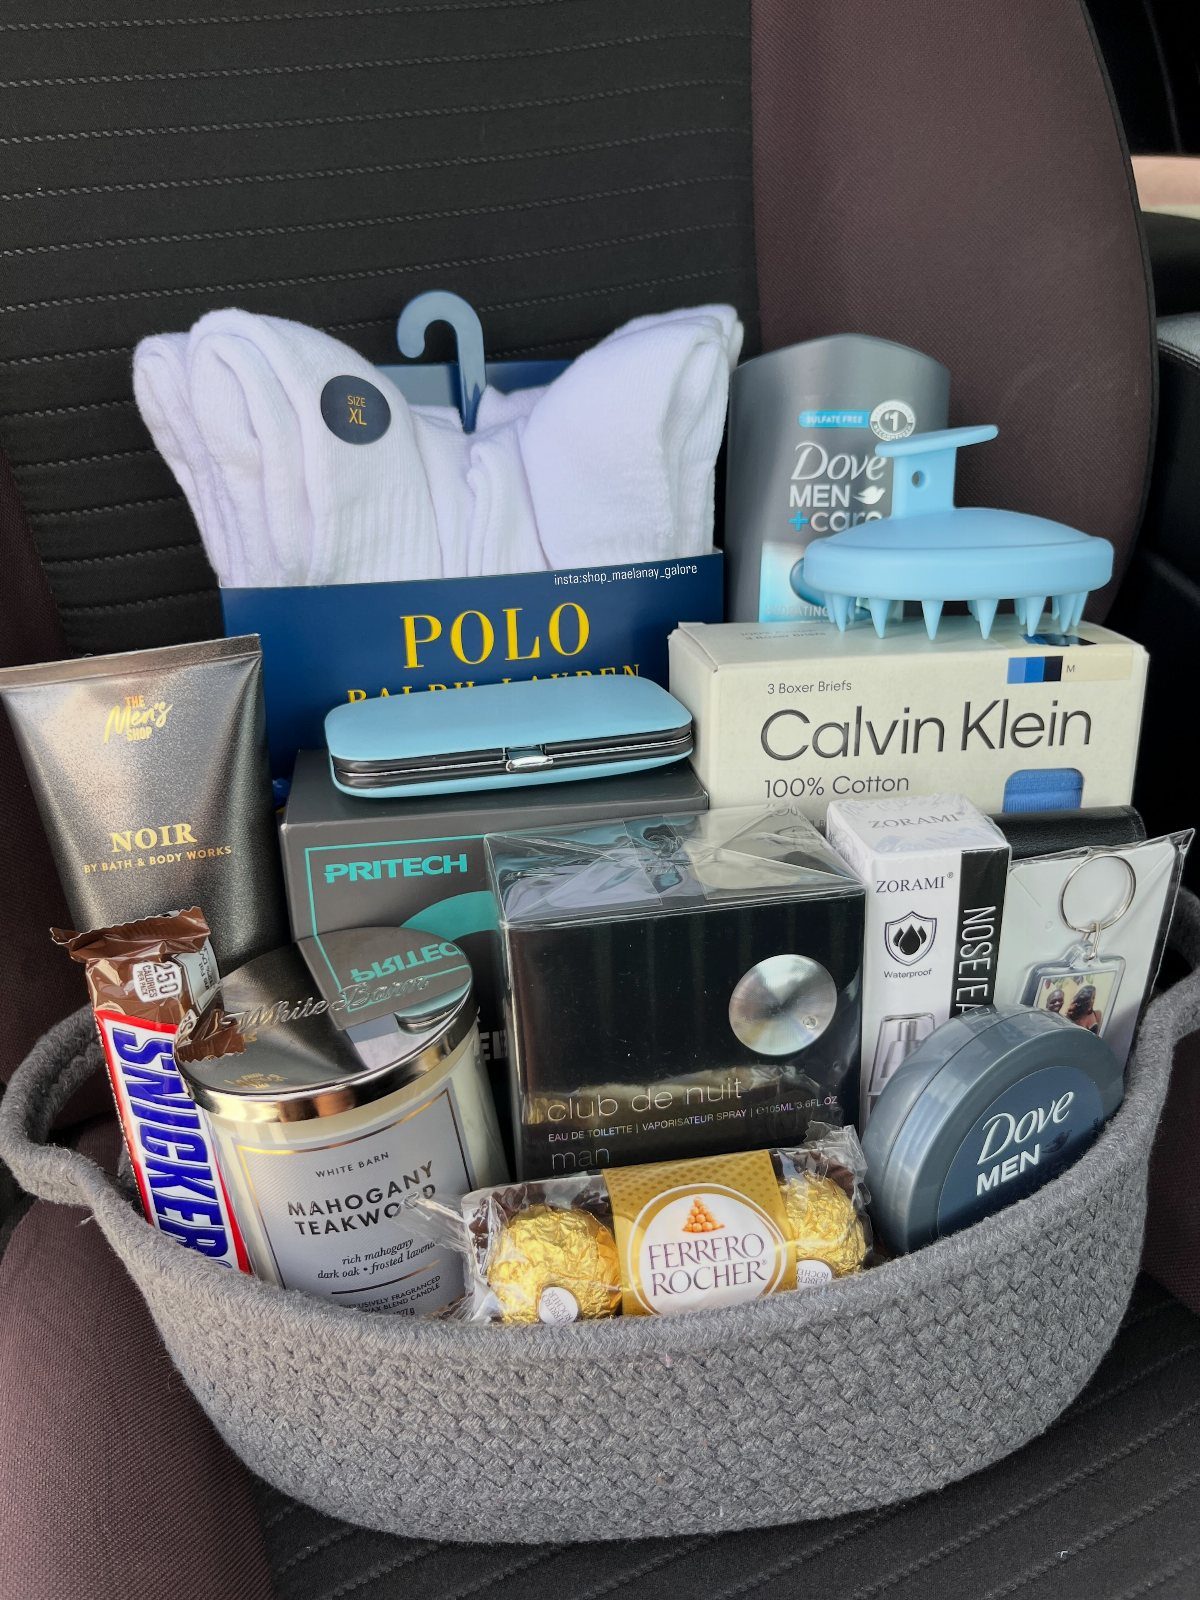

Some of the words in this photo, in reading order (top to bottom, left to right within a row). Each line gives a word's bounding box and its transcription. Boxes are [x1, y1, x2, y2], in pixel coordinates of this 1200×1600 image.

[346, 394, 367, 408] SIZE
[348, 407, 367, 427] XL
[842, 414, 864, 424] FREE
[790, 440, 887, 481] Dove
[788, 484, 850, 508] MEN
[400, 601, 591, 670] POLO
[1066, 664, 1076, 673] M
[124, 695, 145, 709] THE
[767, 683, 775, 695] 3
[778, 681, 814, 695] Boxer
[817, 679, 852, 693] Briefs
[126, 726, 153, 742] SHOP
[760, 705, 945, 762] Calvin
[960, 699, 1092, 752] Klein
[764, 776, 825, 799] 100%
[831, 774, 909, 795] Cotton
[110, 822, 197, 853] NOIR
[83, 863, 97, 875] BY
[101, 859, 133, 873] BATH
[137, 858, 146, 868] &
[149, 852, 183, 867] BODY
[186, 845, 232, 861] WORKS
[323, 853, 468, 884] PRITECH
[959, 906, 996, 974] NOSE
[137, 969, 146, 982] PER
[142, 964, 158, 998] CALORIES
[152, 962, 180, 995] 250
[883, 967, 932, 980] Waterproof
[547, 1093, 618, 1122] club
[631, 1086, 673, 1113] de
[686, 1077, 742, 1105] nuit
[548, 1132, 569, 1143] EAU
[571, 1130, 585, 1140] DE
[588, 1124, 633, 1138] TOILETTE
[642, 1113, 714, 1131] VAPORISATEUR
[716, 1108, 747, 1121] SPRAY
[976, 1091, 1074, 1166] Dove
[112, 1026, 233, 1269] SNICKER
[551, 1148, 610, 1170] man
[315, 1163, 354, 1179] WHITE
[358, 1151, 390, 1169] BARN
[976, 1143, 1040, 1196] MEN
[287, 1160, 433, 1217] MAHOGANY
[317, 1268, 340, 1279] dark
[342, 1265, 360, 1278] oak
[369, 1253, 403, 1275] frosted
[407, 1240, 437, 1260] laven
[342, 1253, 361, 1265] rich
[364, 1238, 414, 1261] mahogany
[648, 1233, 765, 1270] FERRERO
[383, 1298, 409, 1310] BLEND
[410, 1282, 441, 1302] CANDLE
[391, 1275, 441, 1301] FRAGRANCED
